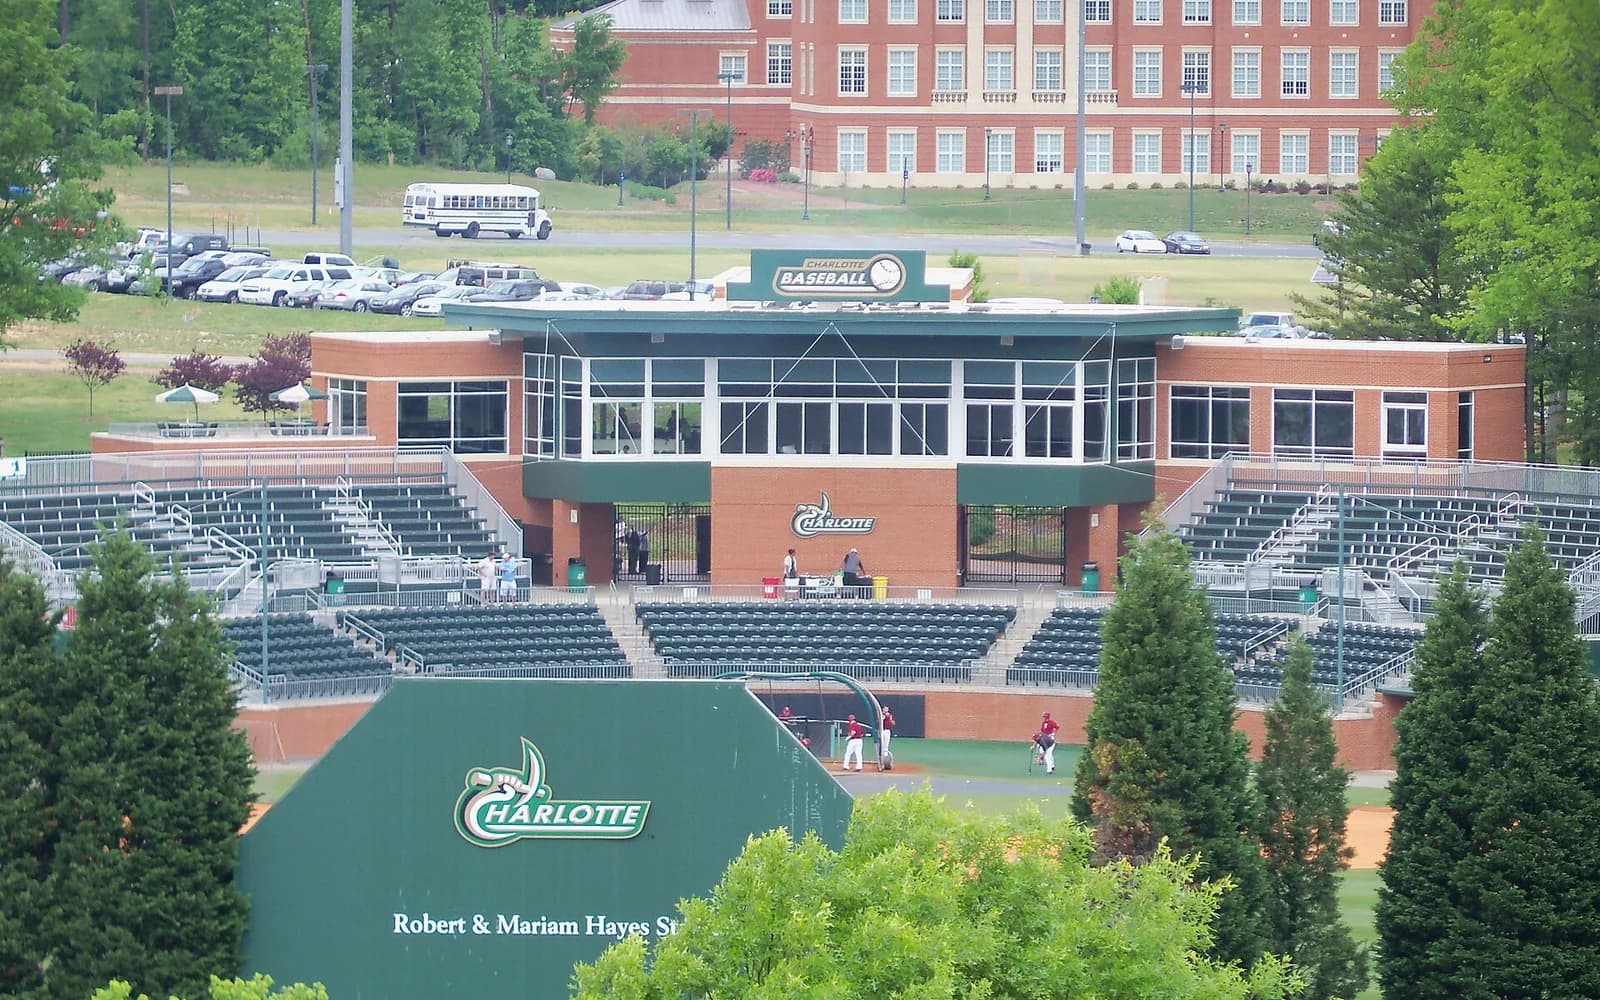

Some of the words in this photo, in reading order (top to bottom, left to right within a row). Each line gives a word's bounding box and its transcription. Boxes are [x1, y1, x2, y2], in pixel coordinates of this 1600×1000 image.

[780, 271, 867, 285] BASEBALL
[806, 260, 865, 269] CHARLOTTE
[792, 509, 874, 536] CHARLOTTE
[461, 780, 643, 841] CHARLOTTE
[393, 912, 466, 935] Robert
[472, 914, 491, 935] &
[496, 914, 579, 936] Mariam
[585, 915, 650, 940] Hayes
